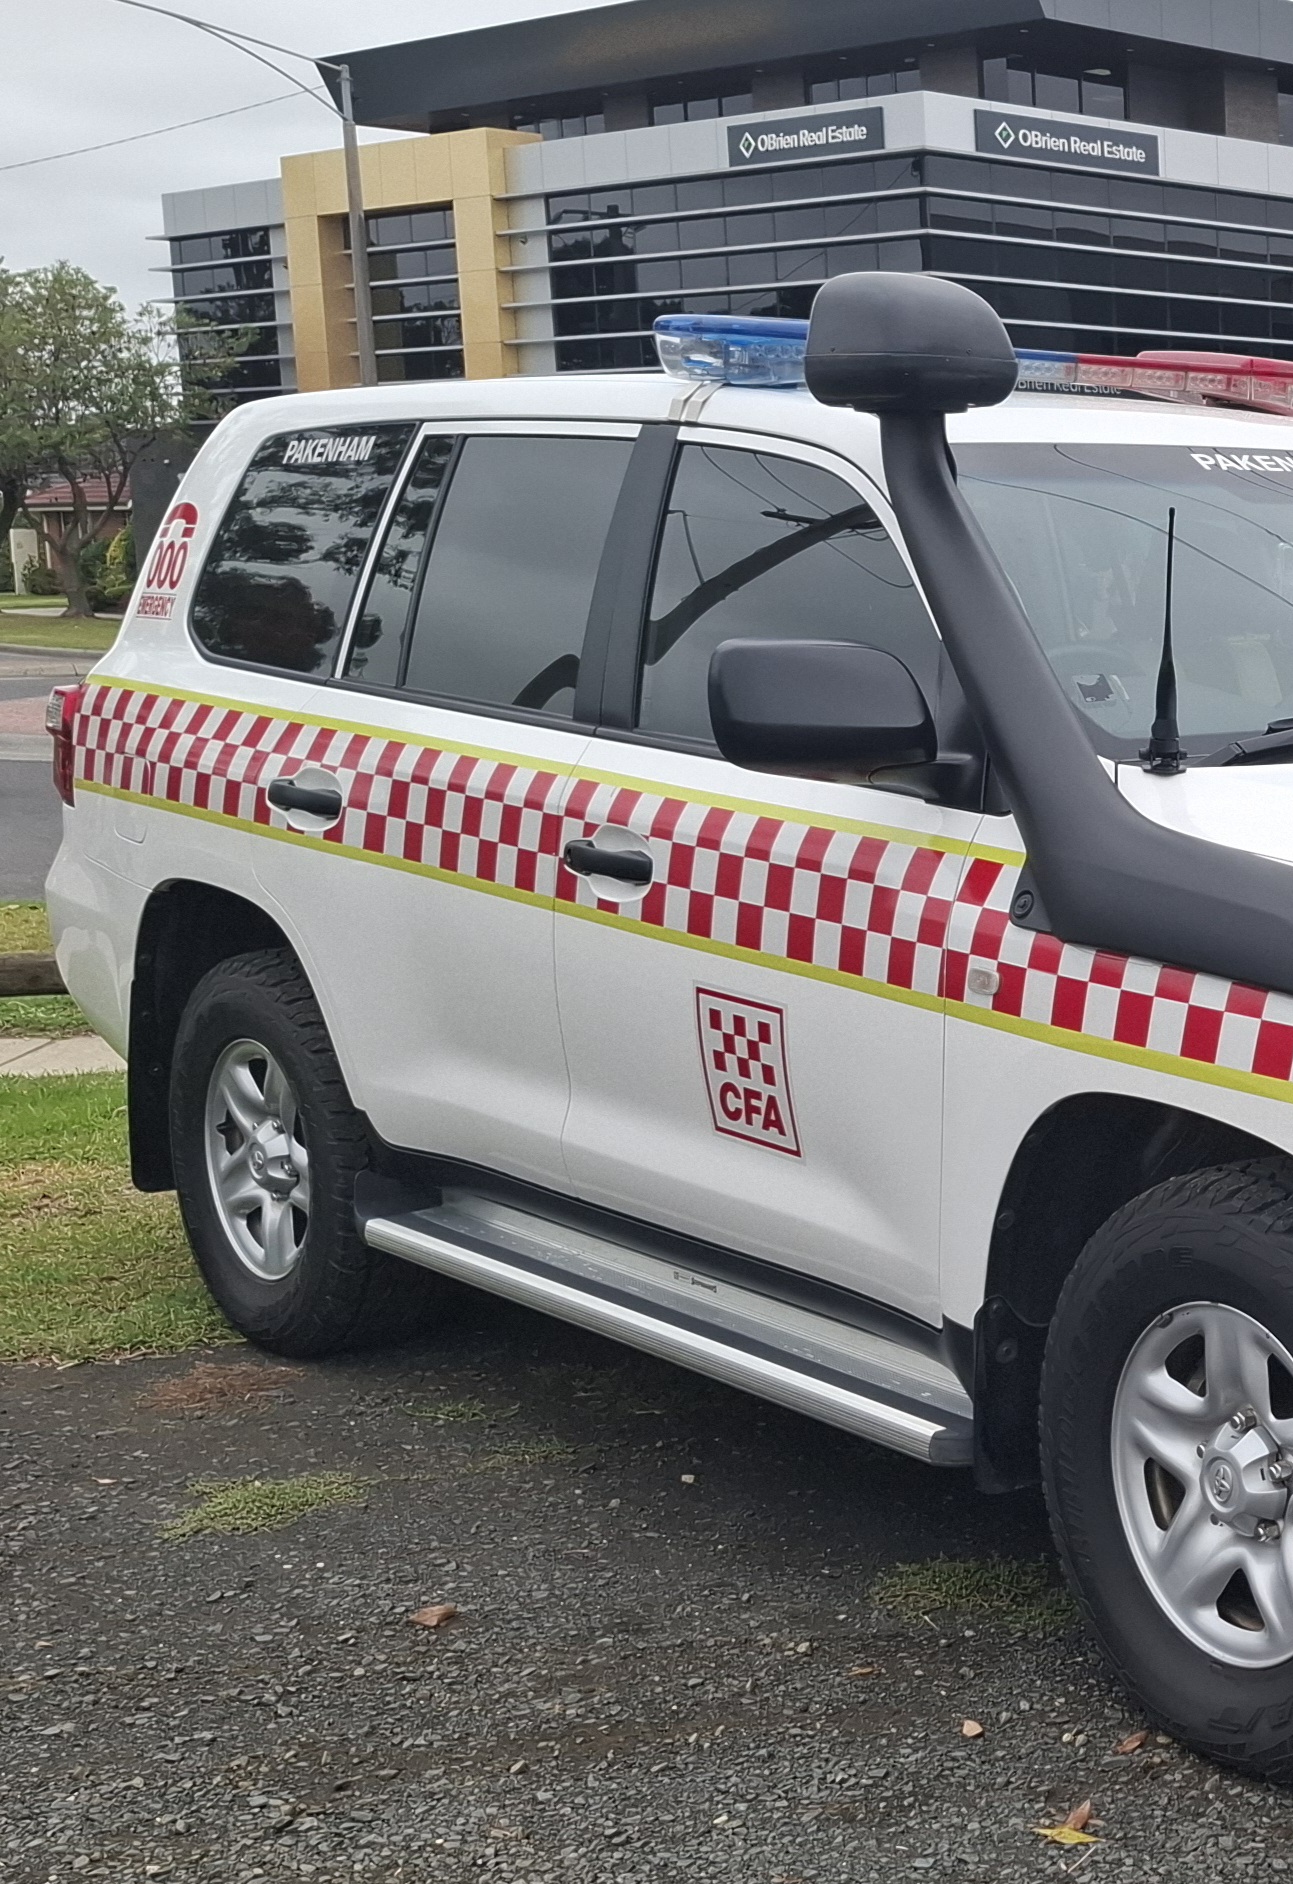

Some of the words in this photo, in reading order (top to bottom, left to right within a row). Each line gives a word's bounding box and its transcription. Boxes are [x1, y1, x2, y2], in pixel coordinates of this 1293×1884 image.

[757, 132, 798, 152] OBrien
[800, 126, 826, 147] Real
[828, 124, 867, 143] Estate
[1018, 129, 1068, 152] OBrien
[1070, 136, 1102, 156] Real
[1103, 141, 1146, 162] Estate
[282, 436, 377, 465] PAKENHAM
[146, 540, 188, 590] 000
[719, 1081, 787, 1137] CFA
